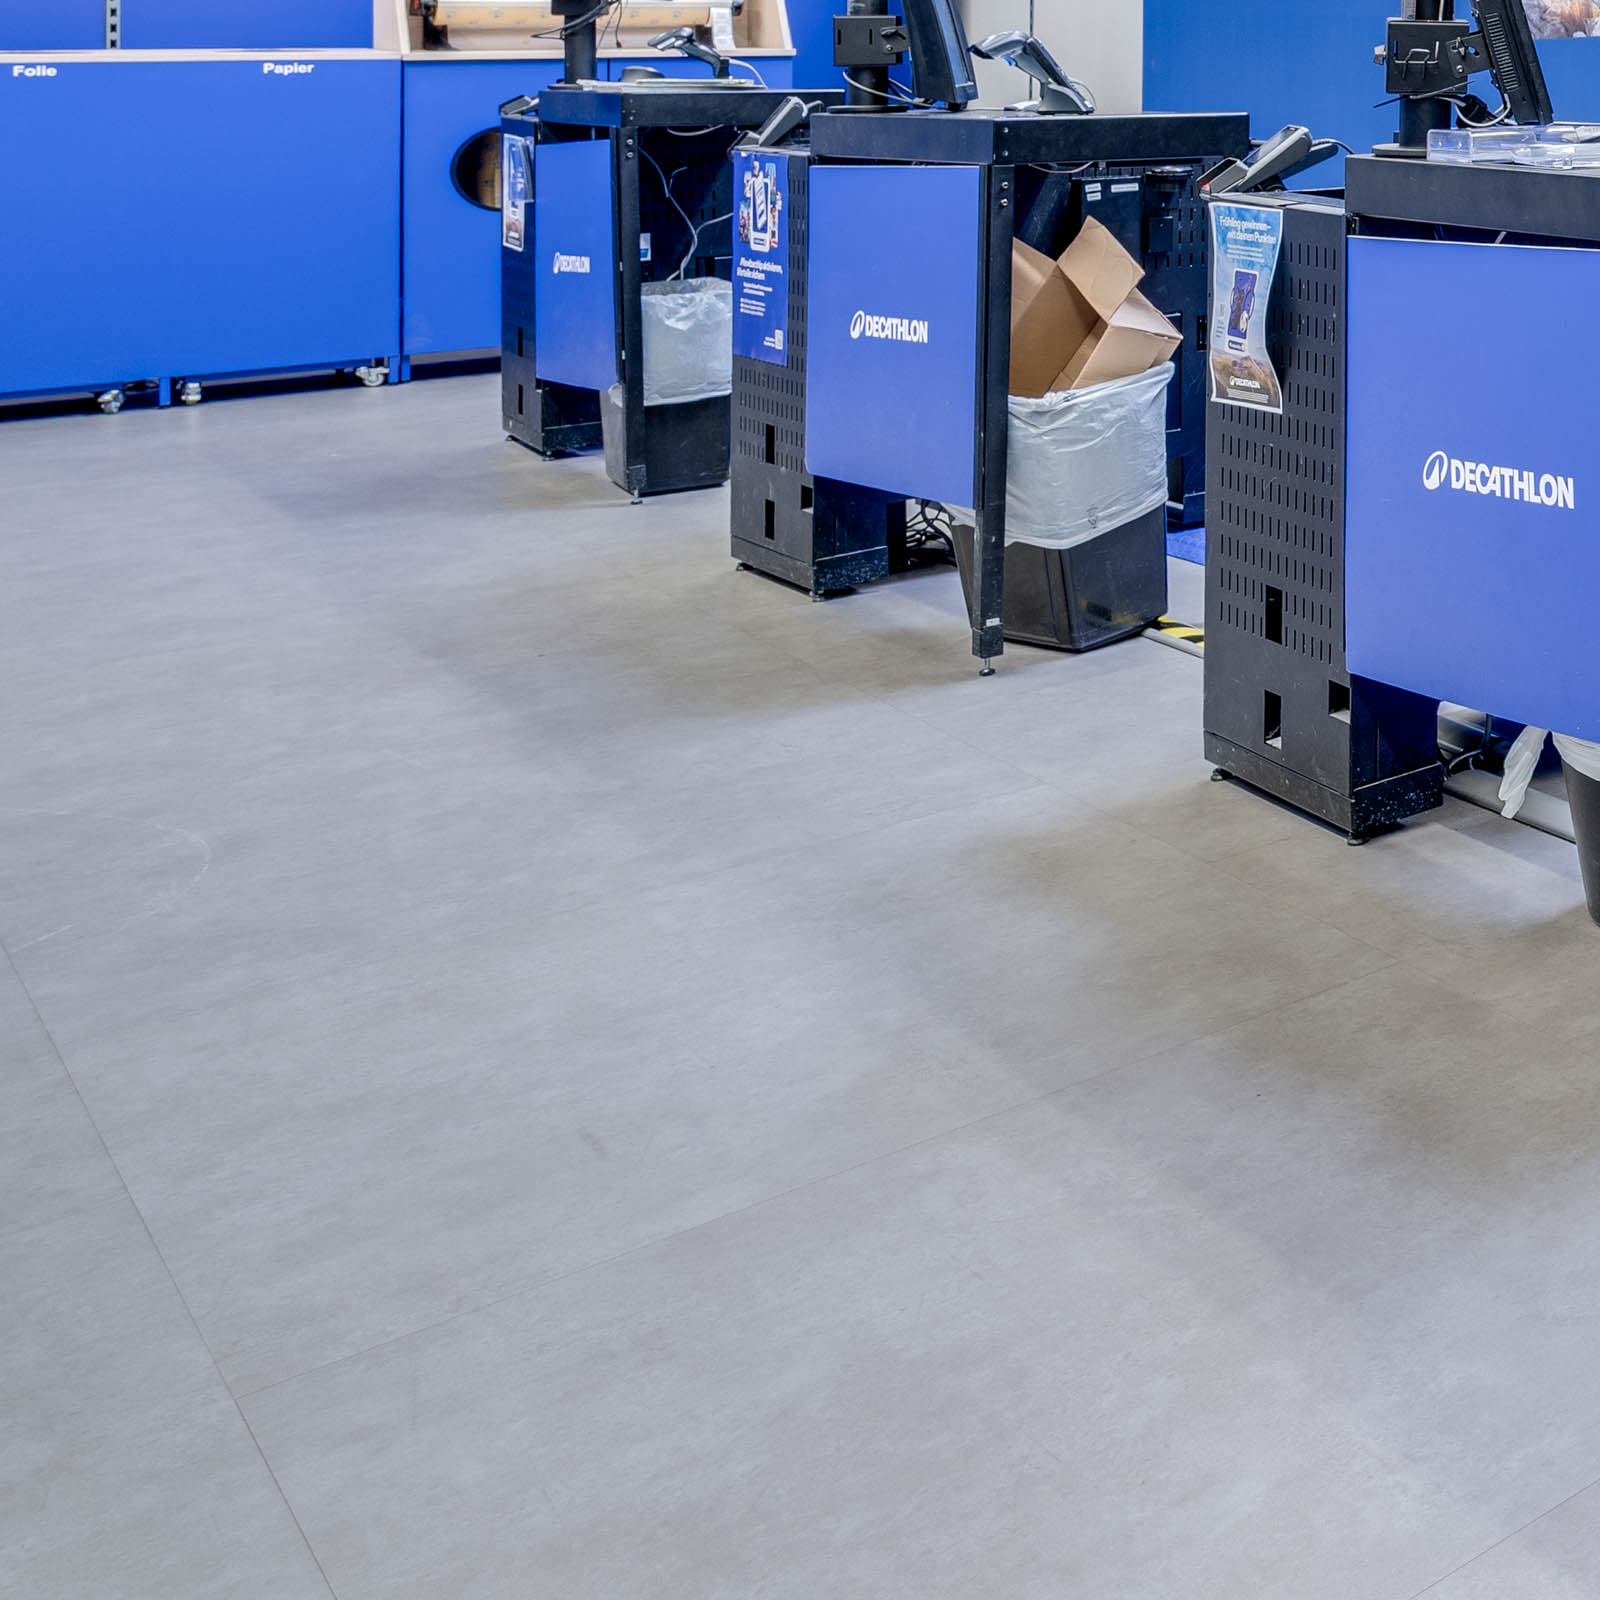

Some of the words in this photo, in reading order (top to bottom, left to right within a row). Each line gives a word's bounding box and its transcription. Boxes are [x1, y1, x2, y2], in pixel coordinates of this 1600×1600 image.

[12, 65, 58, 77] Folie
[263, 62, 315, 76] Papier
[866, 314, 928, 344] DECATHLON
[1451, 459, 1574, 509] DECATHLON
